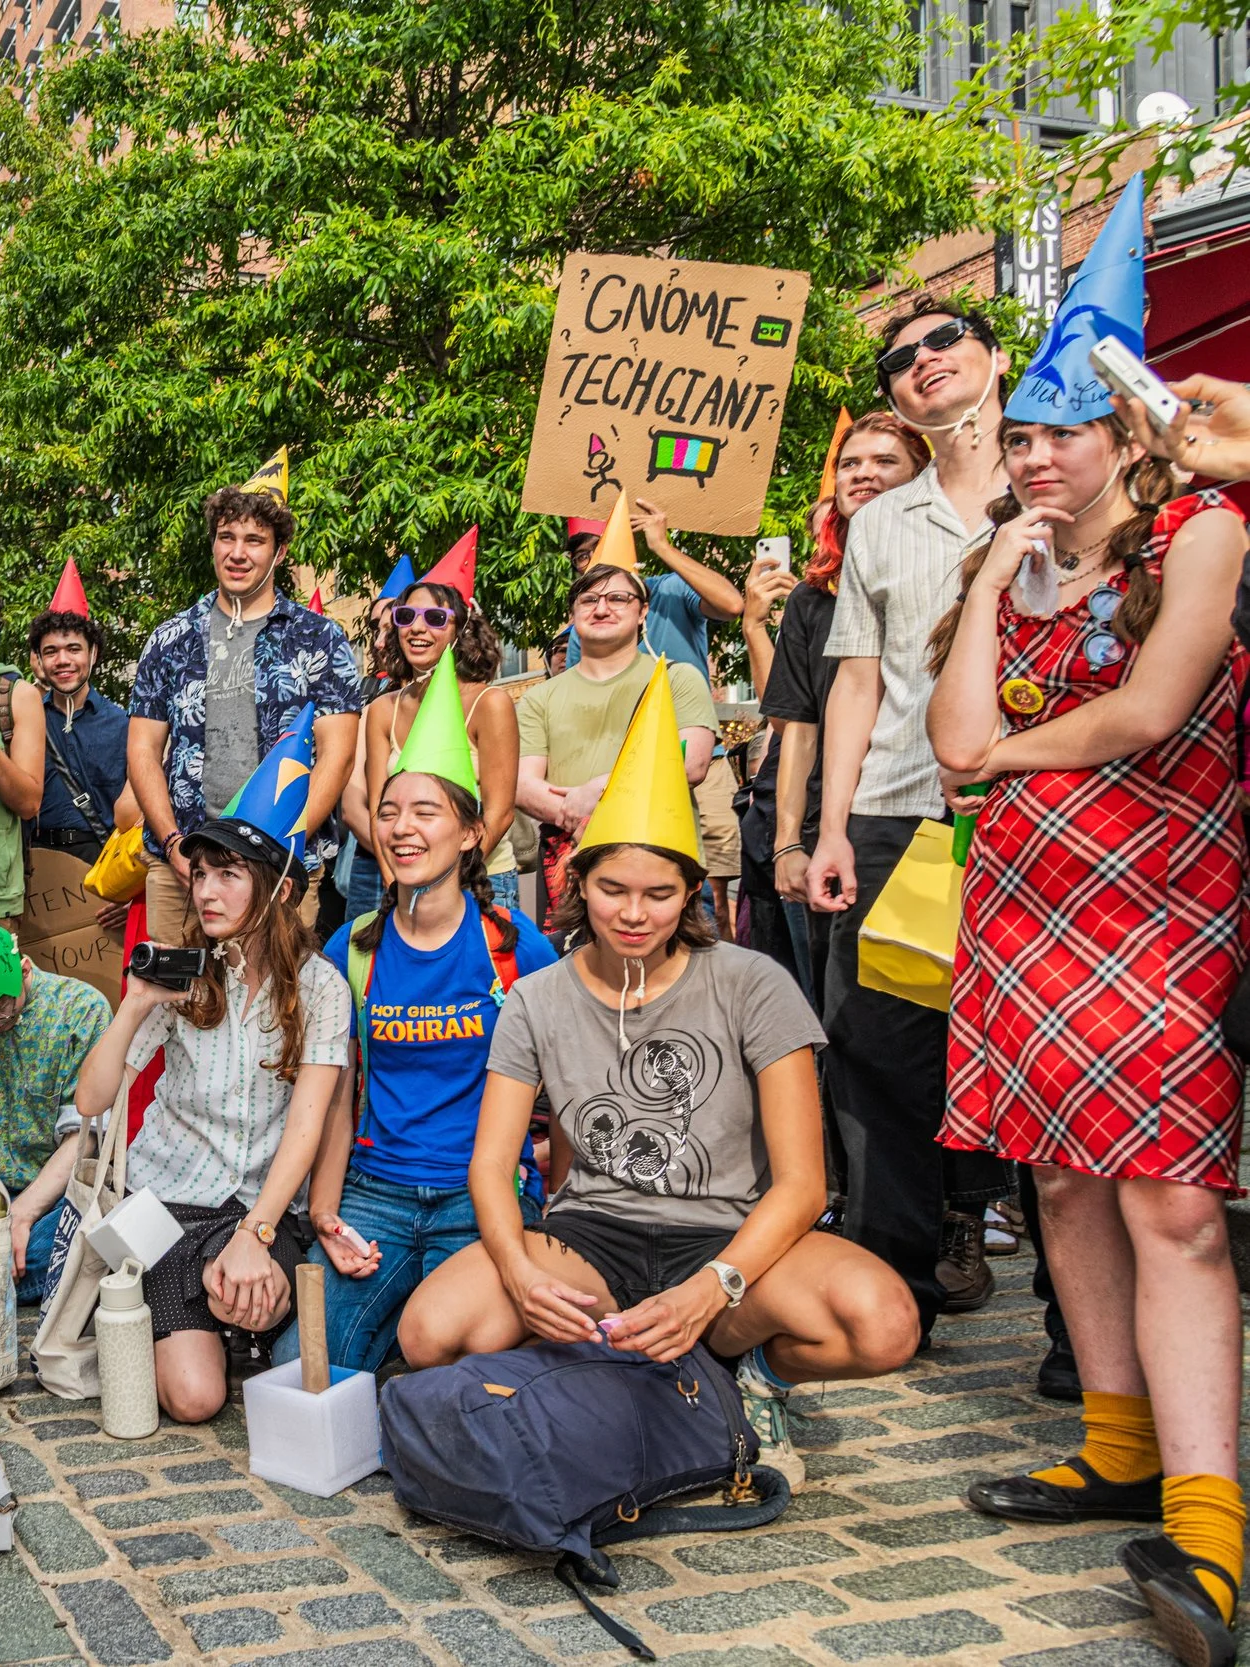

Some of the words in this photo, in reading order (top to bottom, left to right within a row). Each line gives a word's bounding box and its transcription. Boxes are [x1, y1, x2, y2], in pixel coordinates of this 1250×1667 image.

[585, 274, 748, 349] GNOME
[760, 325, 782, 337] or
[1026, 378, 1062, 409] Ned
[1068, 380, 1113, 411] Lu
[27, 883, 87, 917] TEN
[40, 936, 123, 974] YOUR
[371, 1004, 404, 1018] HOT
[407, 1005, 457, 1018] GIRLS
[458, 1000, 482, 1013] FOR
[370, 1015, 485, 1042] ZOHRAN
